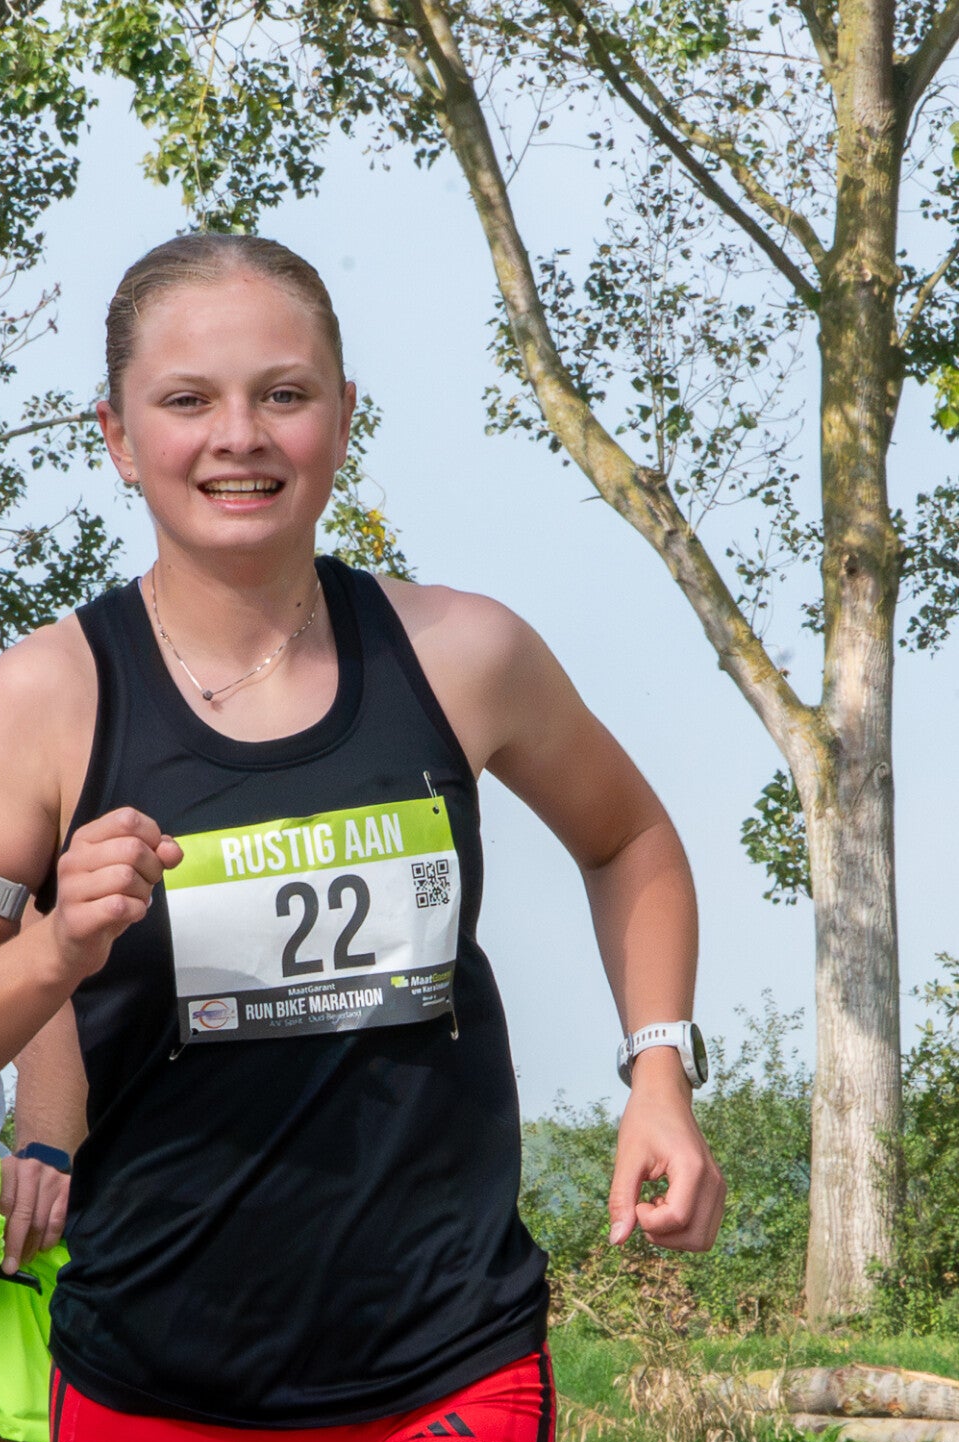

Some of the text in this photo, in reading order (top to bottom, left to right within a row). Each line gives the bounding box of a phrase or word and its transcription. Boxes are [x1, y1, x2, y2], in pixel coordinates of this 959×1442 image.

[221, 812, 404, 877] RUSTIG AAN
[275, 874, 376, 978] 22
[245, 1002, 275, 1021] RUN
[276, 997, 307, 1018] BIKE
[309, 988, 383, 1015] MARATHON
[288, 982, 336, 996] MaatGarant
